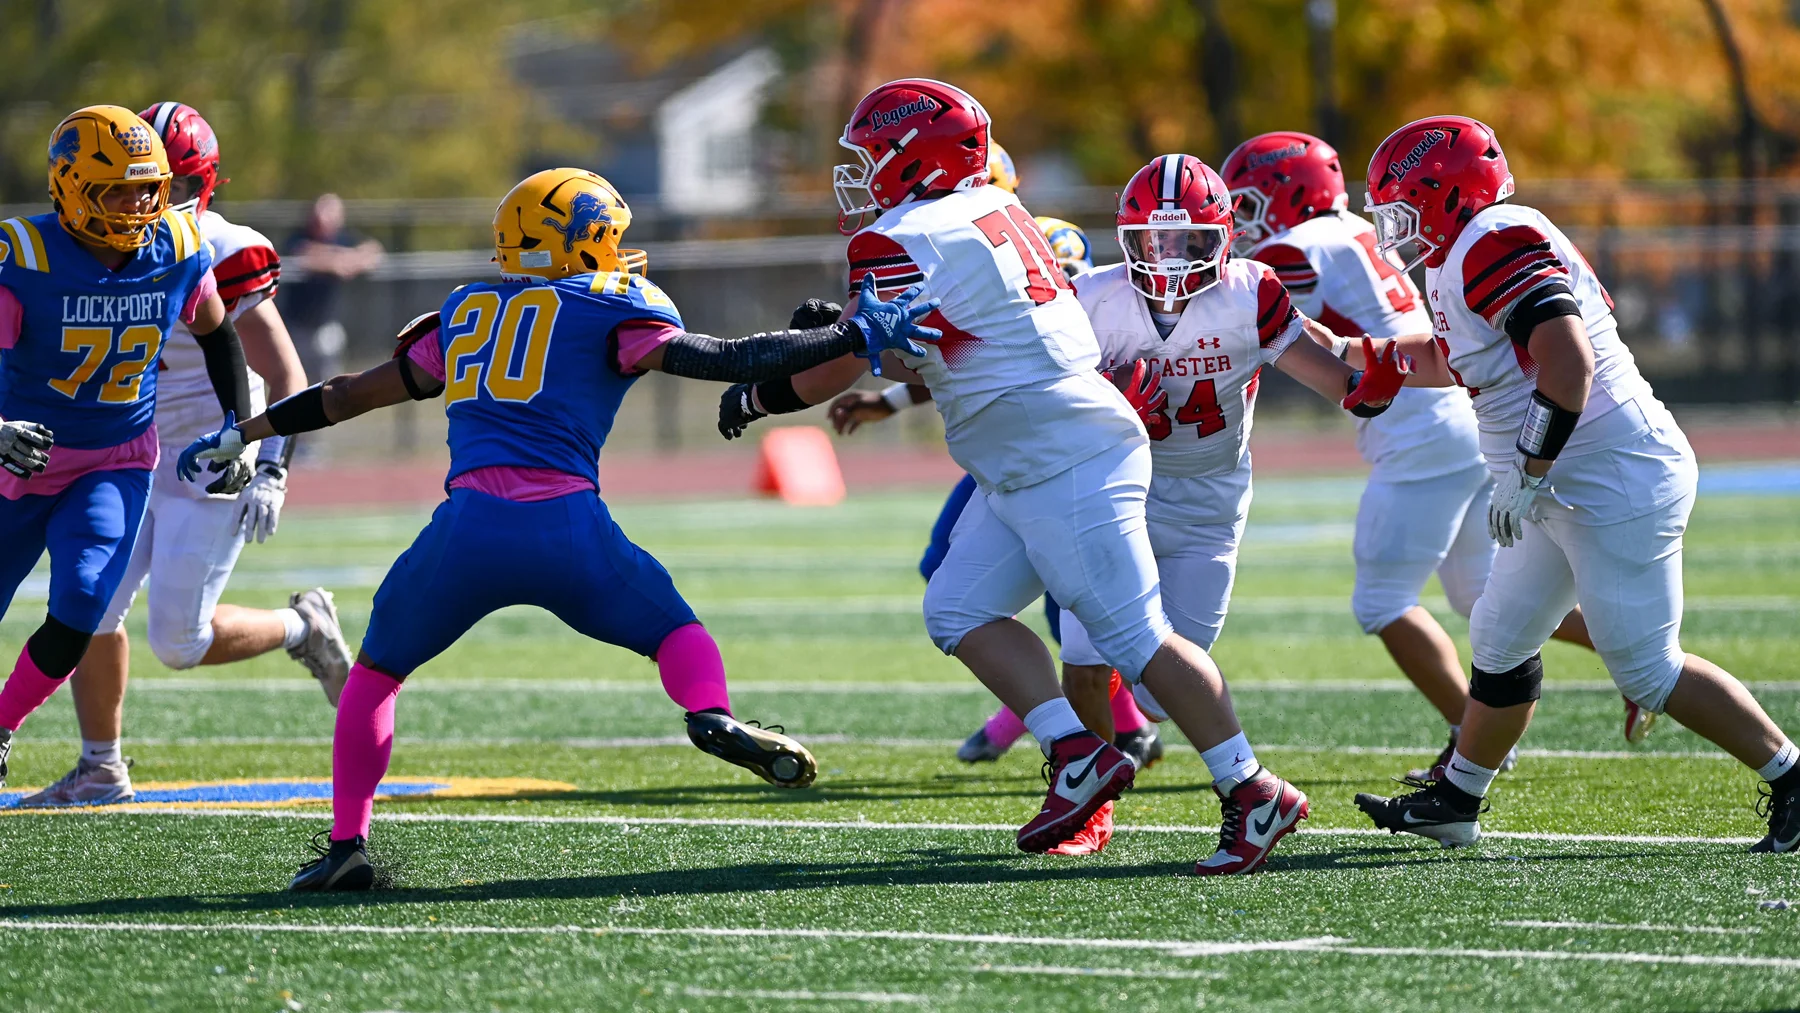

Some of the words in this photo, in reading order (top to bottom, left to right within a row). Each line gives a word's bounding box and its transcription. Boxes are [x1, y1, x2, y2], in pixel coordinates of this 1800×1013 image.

[872, 94, 936, 132] Legends
[130, 166, 158, 176] Riddell
[1390, 129, 1446, 183] Legends
[1152, 213, 1186, 222] Riddell
[61, 291, 166, 323] LOCKPORT
[872, 311, 894, 338] adidas
[47, 323, 163, 404] 72
[445, 286, 563, 411] 20
[1110, 355, 1232, 378] CASTER
